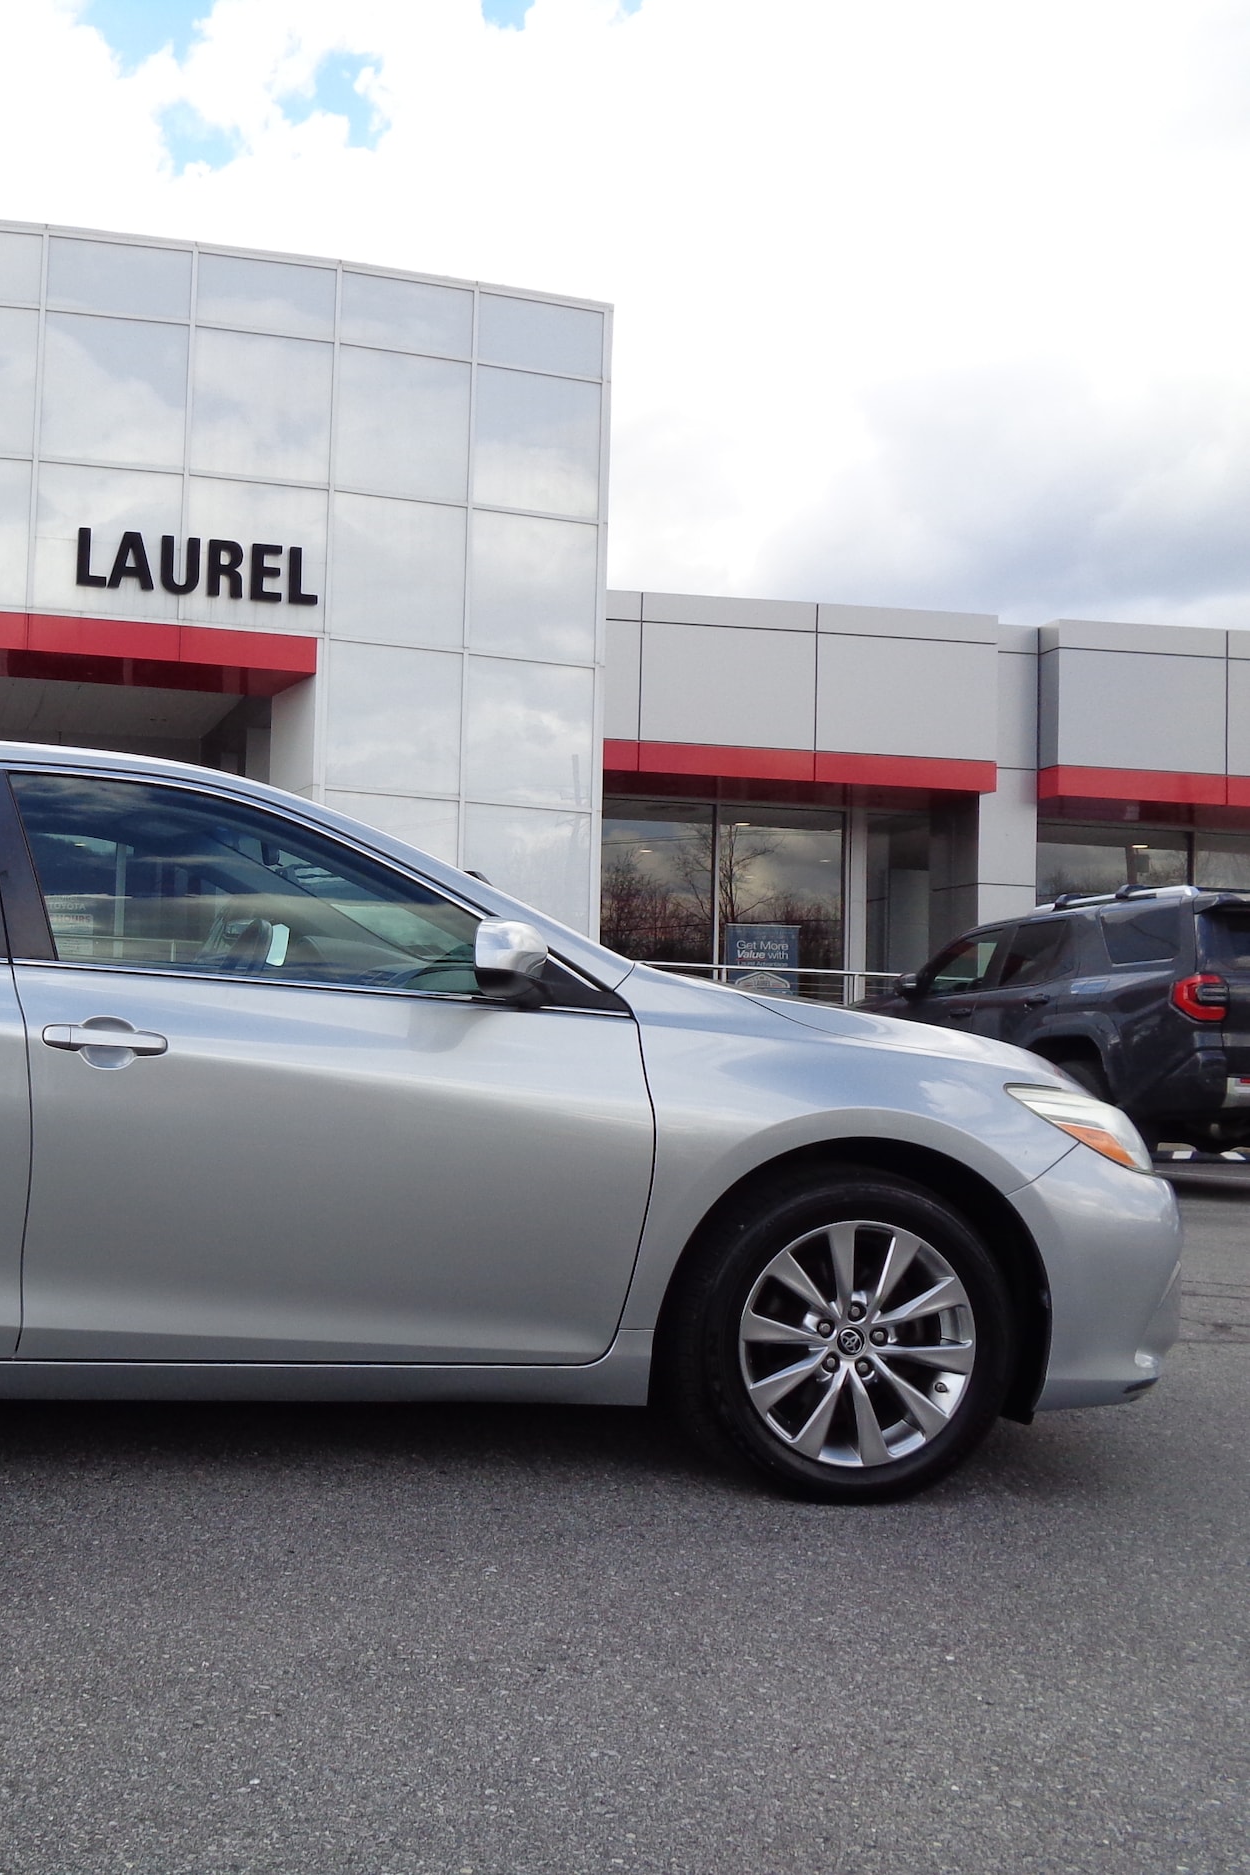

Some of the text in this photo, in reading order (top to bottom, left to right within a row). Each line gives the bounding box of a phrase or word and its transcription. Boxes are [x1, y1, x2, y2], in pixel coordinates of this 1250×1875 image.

[76, 527, 318, 605] LAUREL
[736, 940, 789, 951] Get More
[737, 950, 789, 960] Value with
